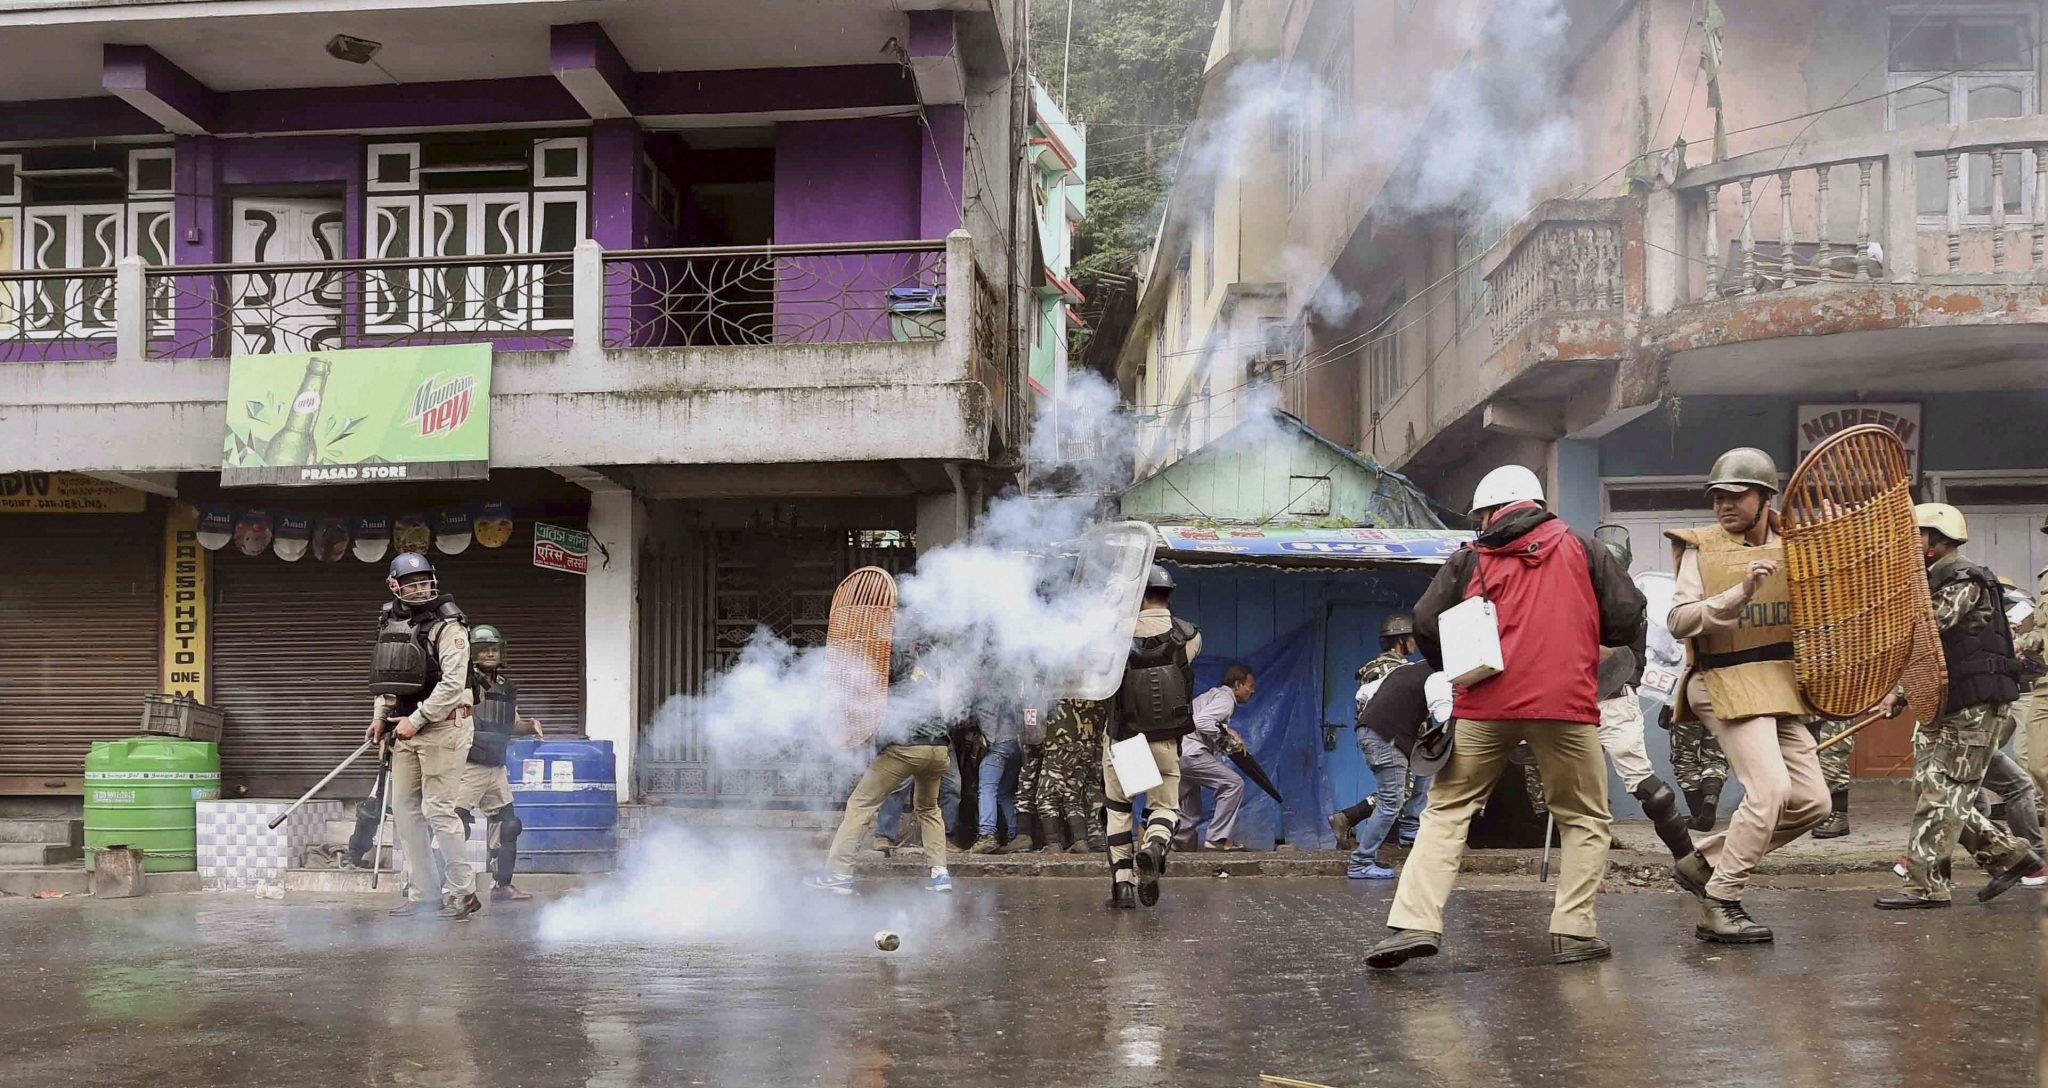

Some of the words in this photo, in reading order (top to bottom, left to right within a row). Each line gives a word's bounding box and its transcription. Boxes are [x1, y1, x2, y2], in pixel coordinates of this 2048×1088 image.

[411, 375, 474, 420] Mountain
[301, 467, 358, 480] PRASAD
[361, 465, 407, 479] STORE
[0, 473, 50, 497] DIO
[206, 512, 231, 523] Amul
[282, 517, 308, 530] Amul
[360, 519, 386, 529] Amul
[536, 545, 565, 561] एरिस
[170, 671, 200, 683] ONE
[1643, 668, 1669, 691] CE
[1024, 708, 1037, 725] CE
